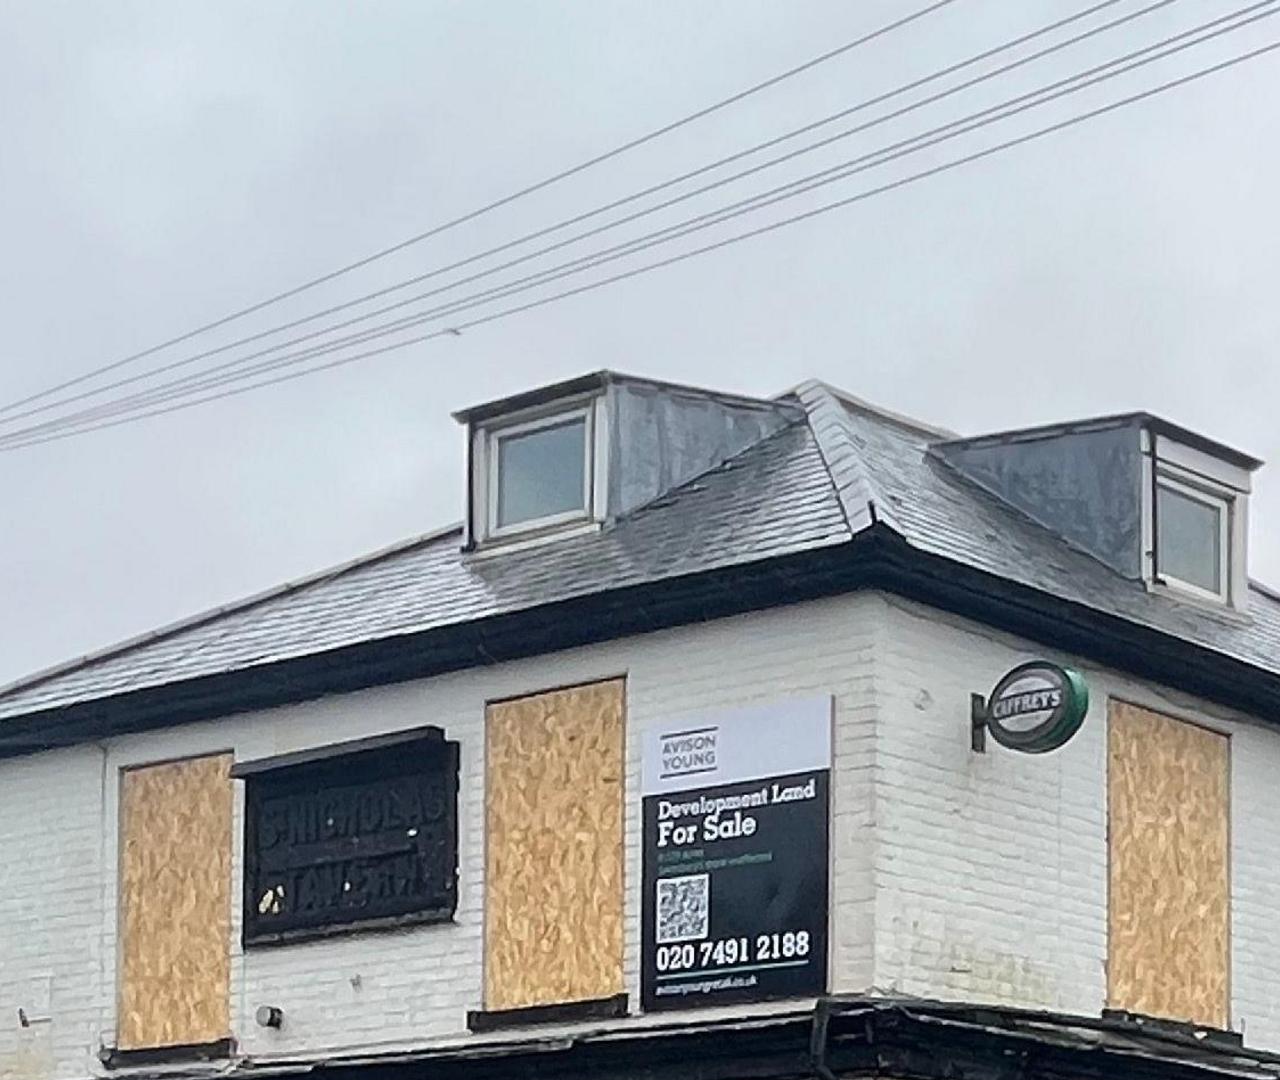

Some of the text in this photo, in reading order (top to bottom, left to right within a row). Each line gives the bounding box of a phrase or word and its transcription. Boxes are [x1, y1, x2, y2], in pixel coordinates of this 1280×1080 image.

[663, 735, 716, 754] AVISON
[663, 751, 716, 770] YOUNG
[657, 779, 816, 820] Development Land
[657, 811, 757, 847] For Sale
[656, 930, 809, 970] 020 7491 2188
